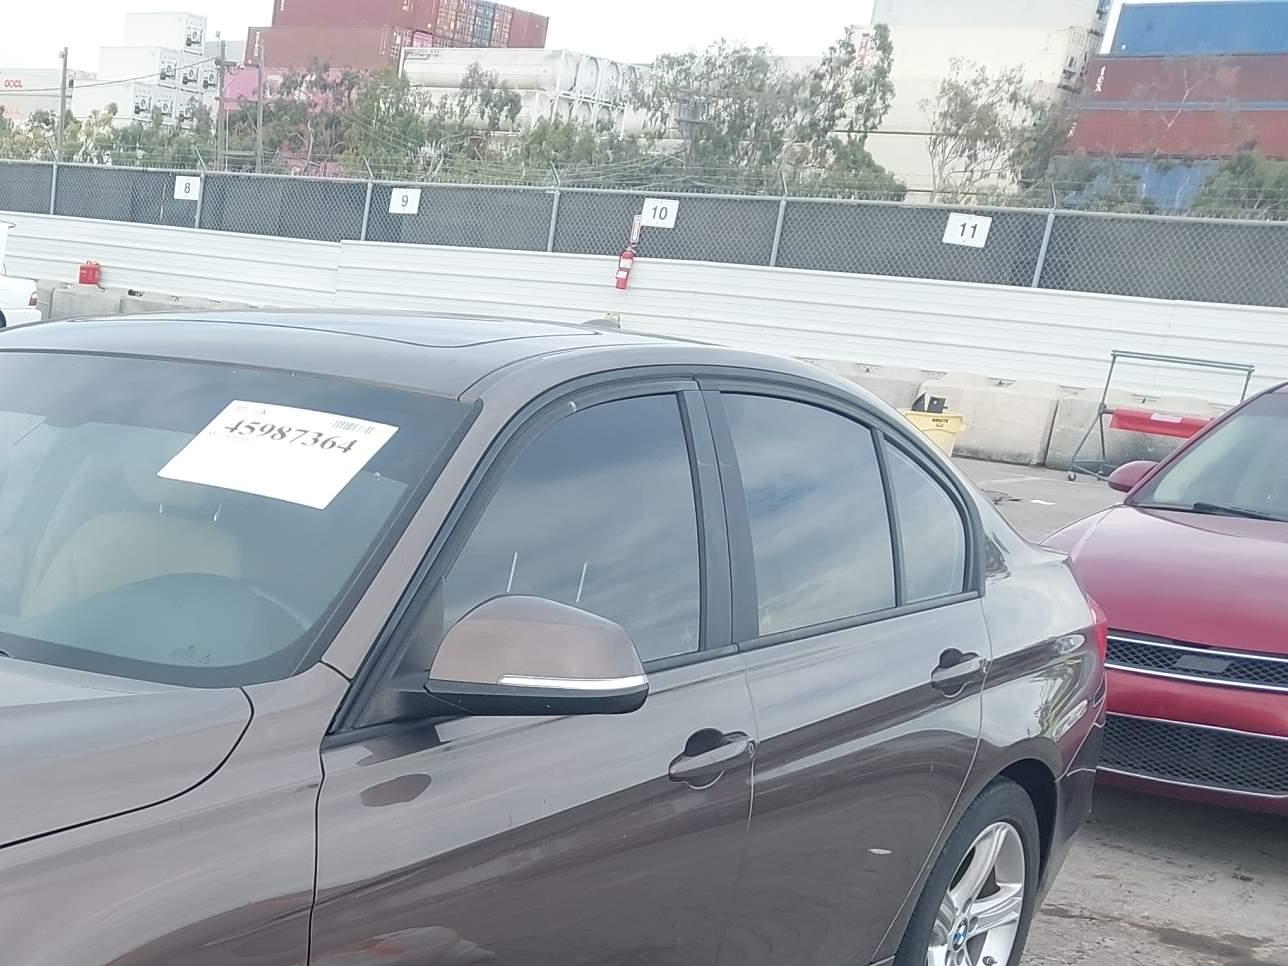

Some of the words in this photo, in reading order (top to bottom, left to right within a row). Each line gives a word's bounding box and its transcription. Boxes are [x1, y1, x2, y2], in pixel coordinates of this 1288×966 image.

[3, 79, 24, 88] OOCL
[183, 182, 192, 195] 8
[400, 194, 409, 208] 9
[650, 205, 669, 221] 10
[959, 222, 978, 239] 11
[223, 419, 359, 454] 45987364
